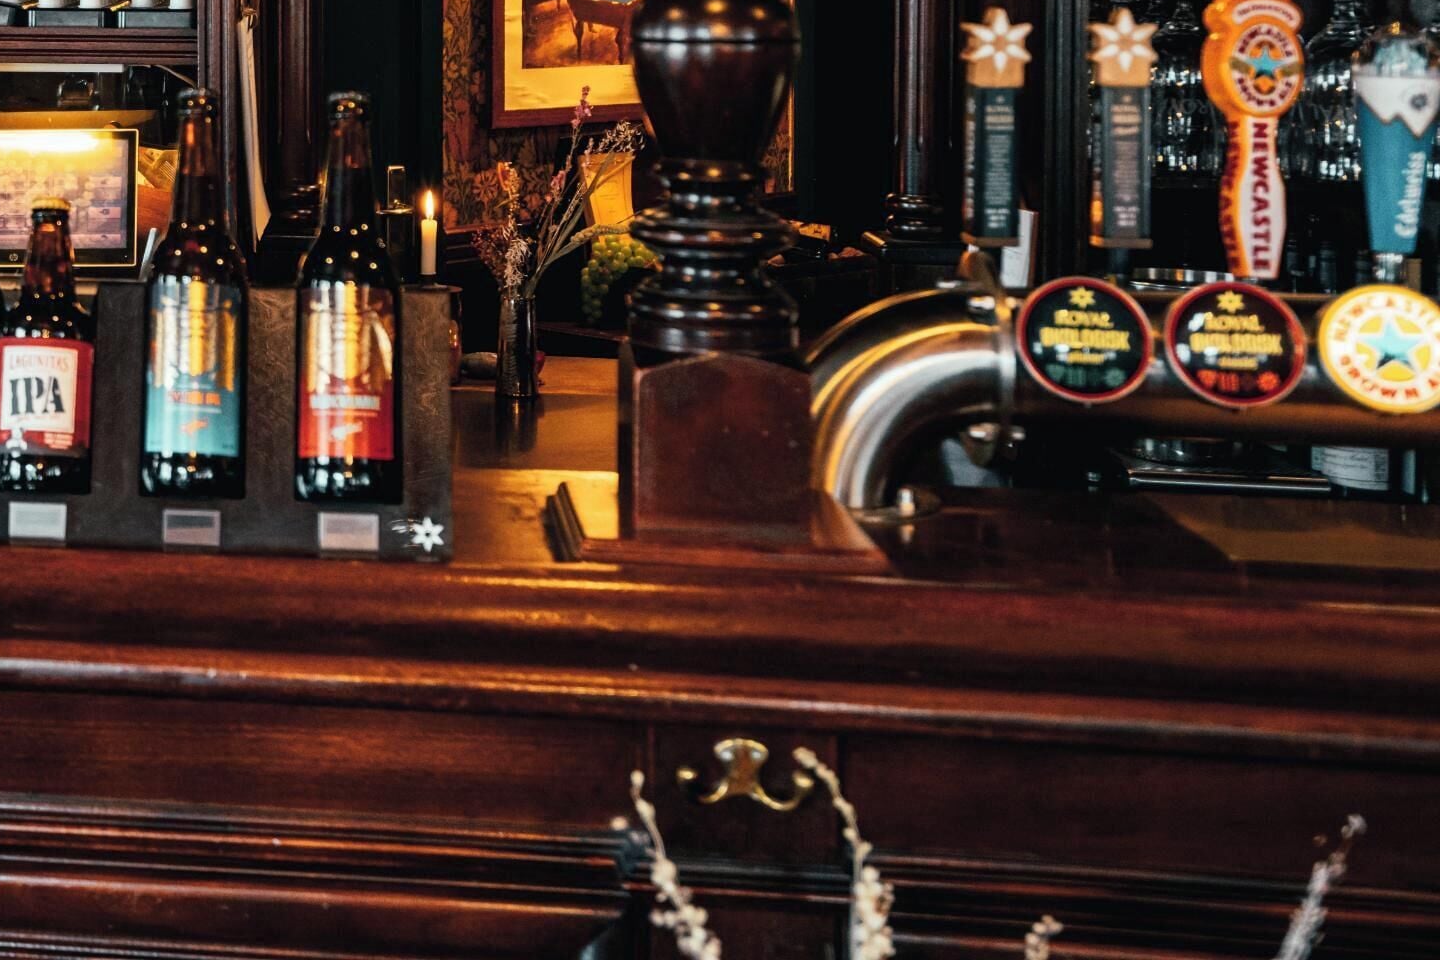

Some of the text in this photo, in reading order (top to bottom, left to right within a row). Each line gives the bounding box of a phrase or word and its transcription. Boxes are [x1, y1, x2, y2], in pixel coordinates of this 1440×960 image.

[1252, 122, 1271, 270] NEWCASTLE
[1394, 151, 1427, 239] Edelweiss
[9, 376, 66, 417] IPA
